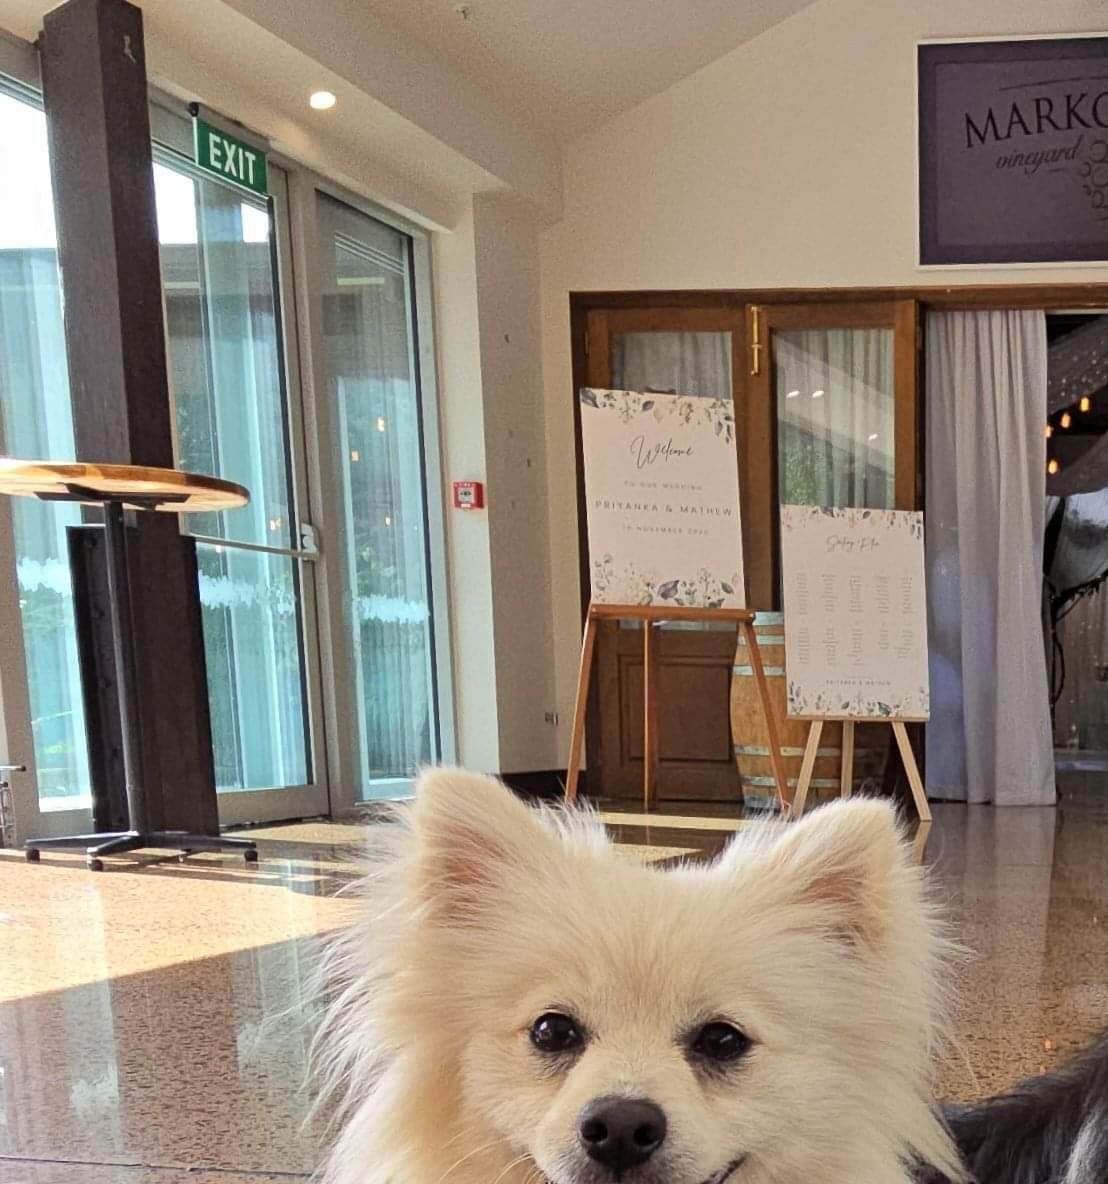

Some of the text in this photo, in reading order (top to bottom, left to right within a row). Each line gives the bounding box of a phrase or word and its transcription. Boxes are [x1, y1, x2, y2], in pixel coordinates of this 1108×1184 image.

[208, 132, 256, 184] EXIT
[996, 134, 1083, 176] vineyard
[630, 434, 694, 469] Welcome
[595, 500, 659, 513] PRIYANKA
[680, 504, 733, 517] MATHEW
